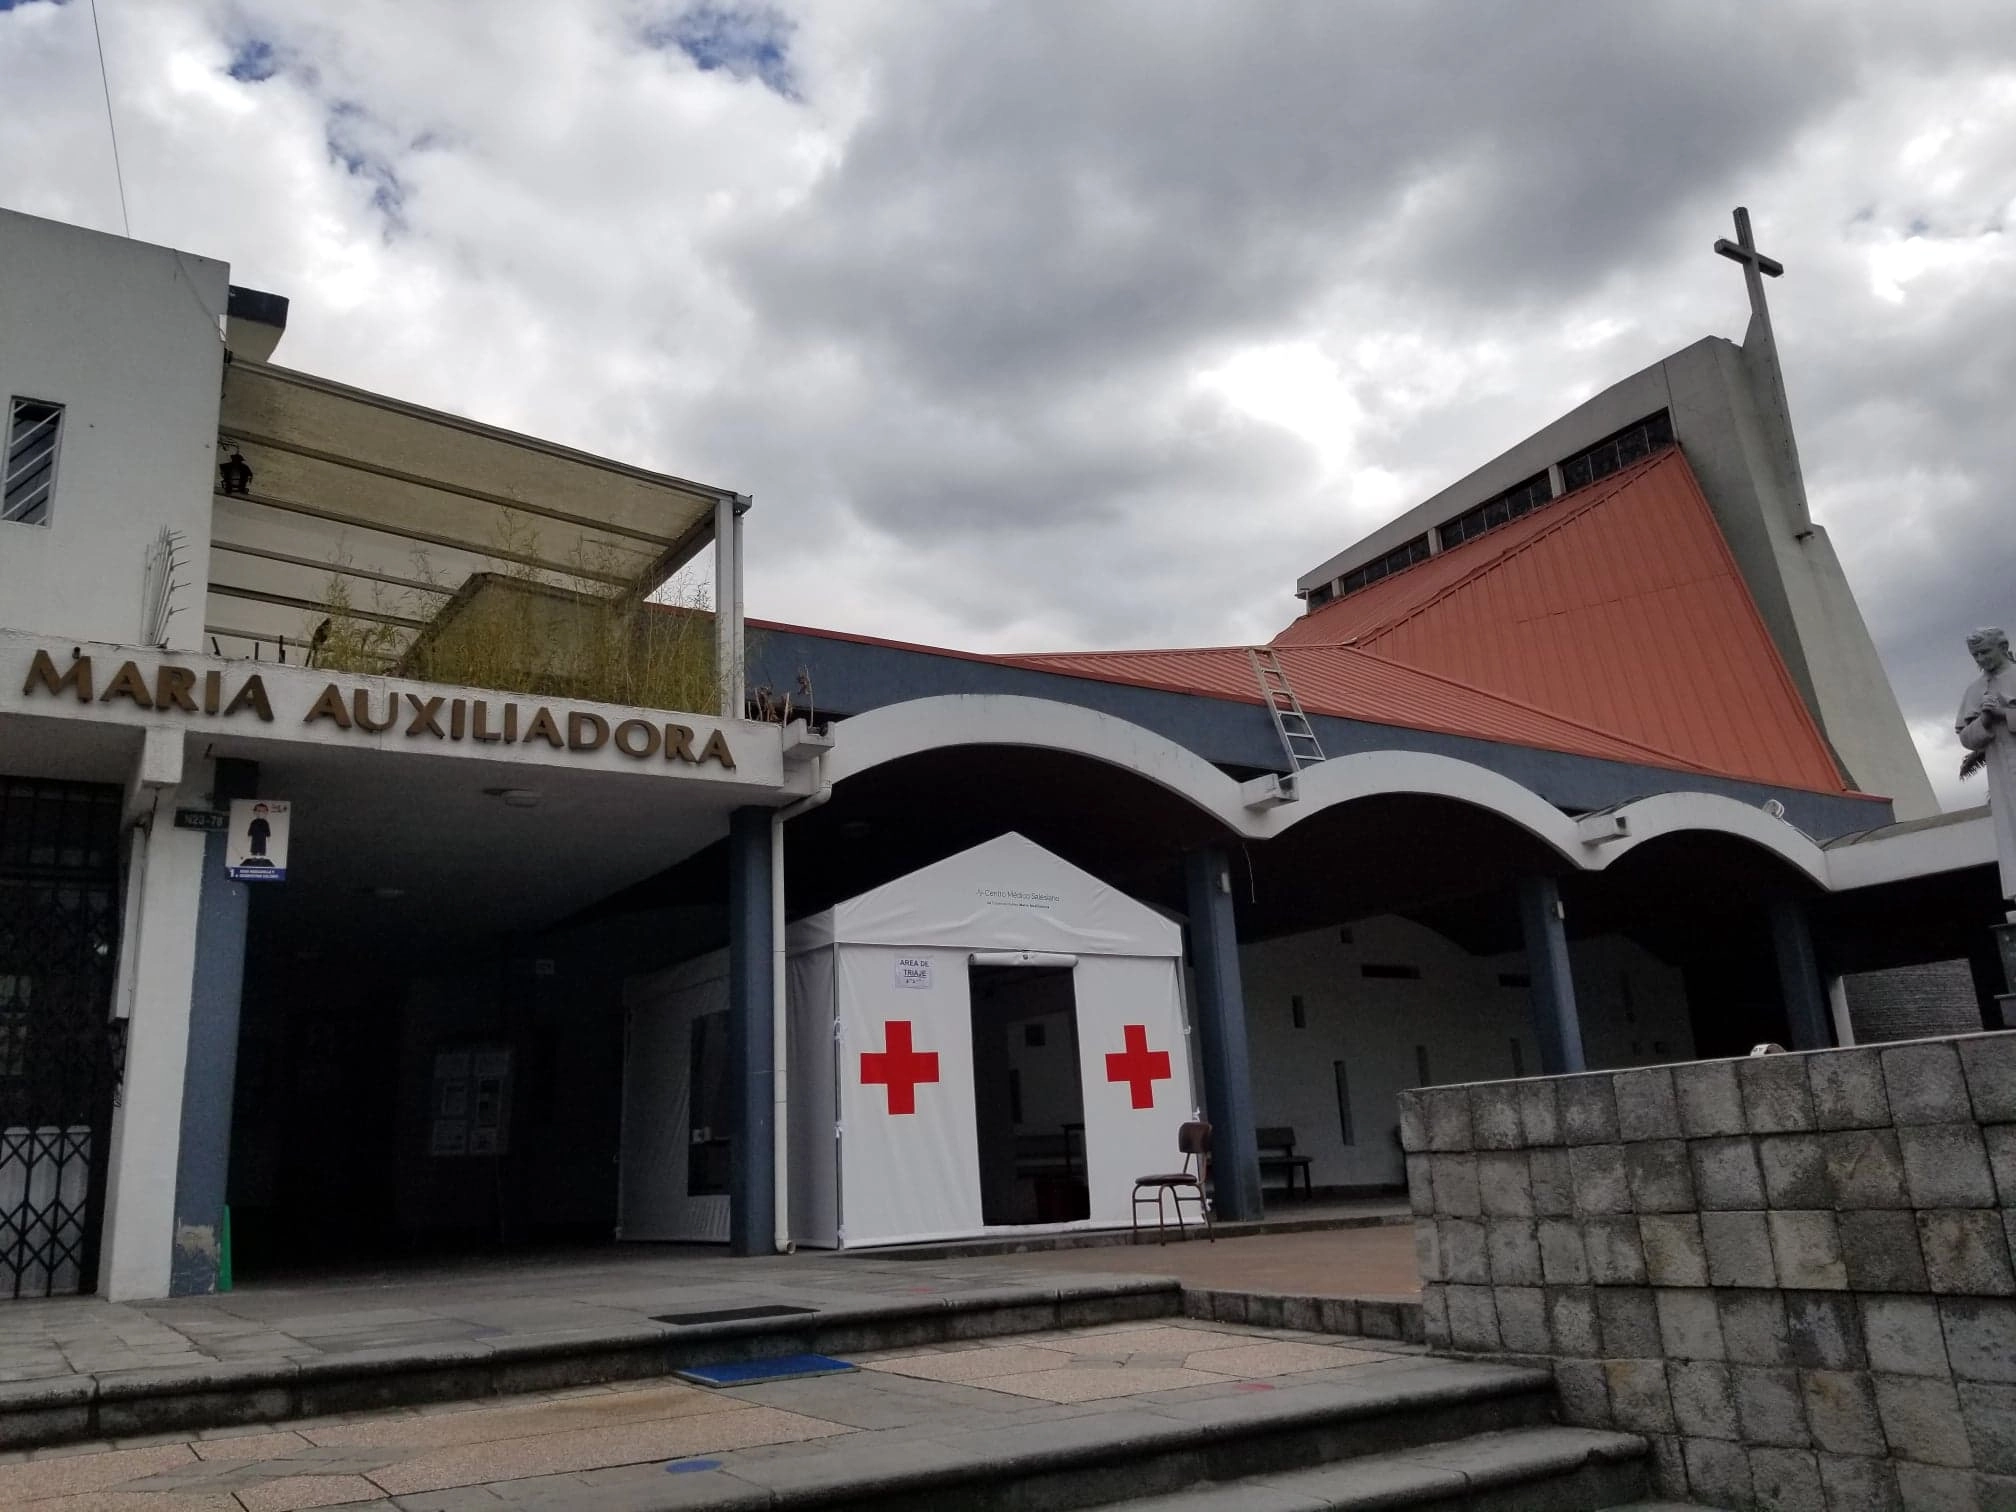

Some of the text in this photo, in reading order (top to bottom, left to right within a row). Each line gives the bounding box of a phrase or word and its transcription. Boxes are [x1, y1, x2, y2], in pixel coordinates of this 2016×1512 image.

[22, 648, 738, 770] MARIA AUXILIADORA
[920, 960, 929, 968] DE
[903, 969, 928, 977] TRIAJE
